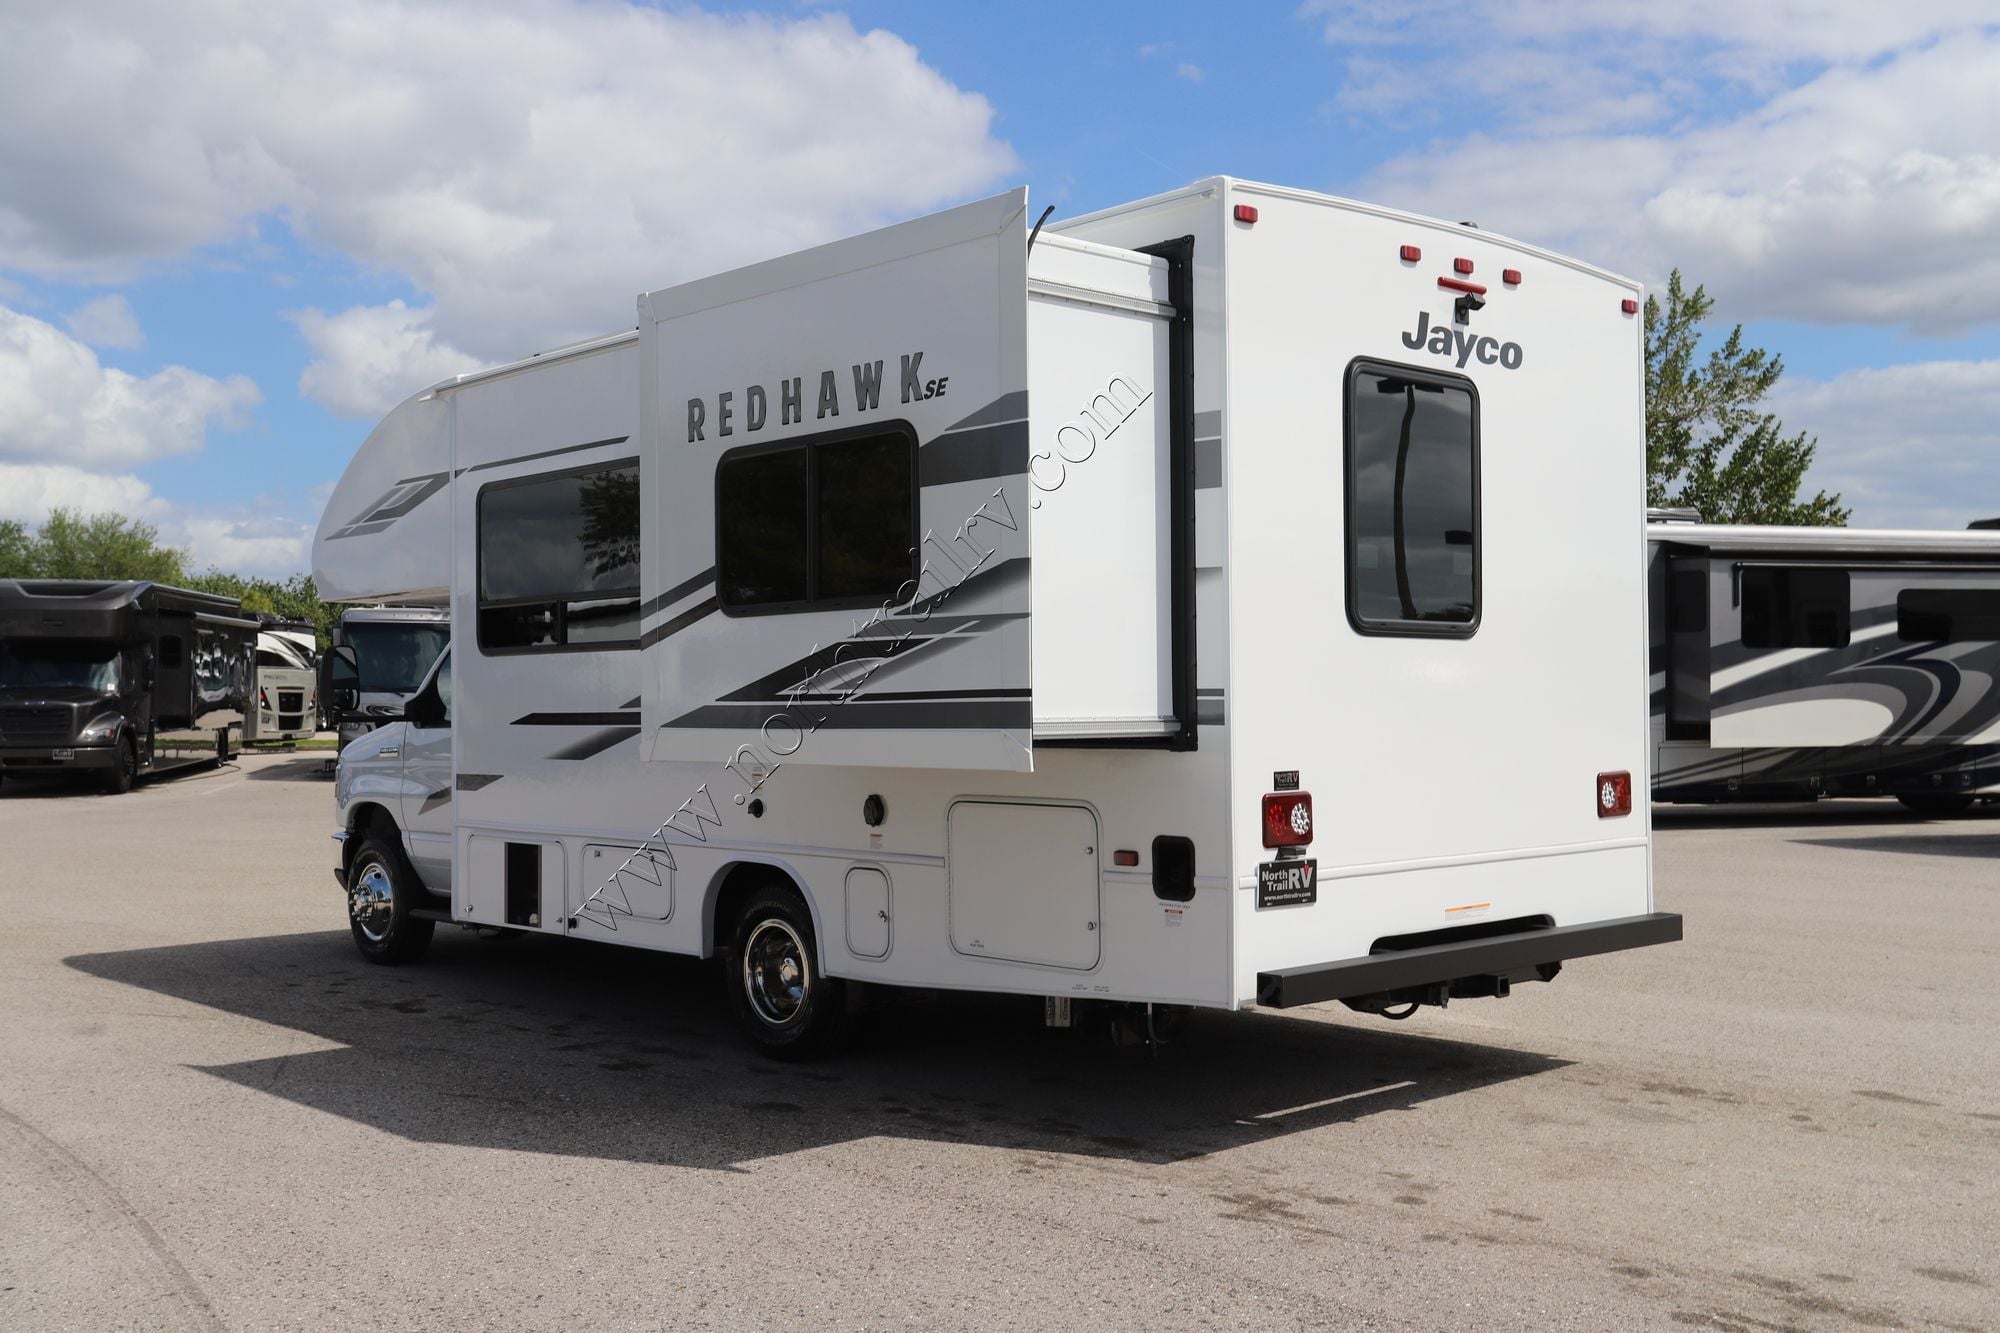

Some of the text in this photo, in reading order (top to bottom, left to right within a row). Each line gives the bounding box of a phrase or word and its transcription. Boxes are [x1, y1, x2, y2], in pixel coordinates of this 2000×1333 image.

[1402, 311, 1523, 370] Jayco
[687, 352, 949, 443] REDHAWK SE
[1261, 866, 1313, 890] North RV
[1266, 879, 1288, 892] Trail
